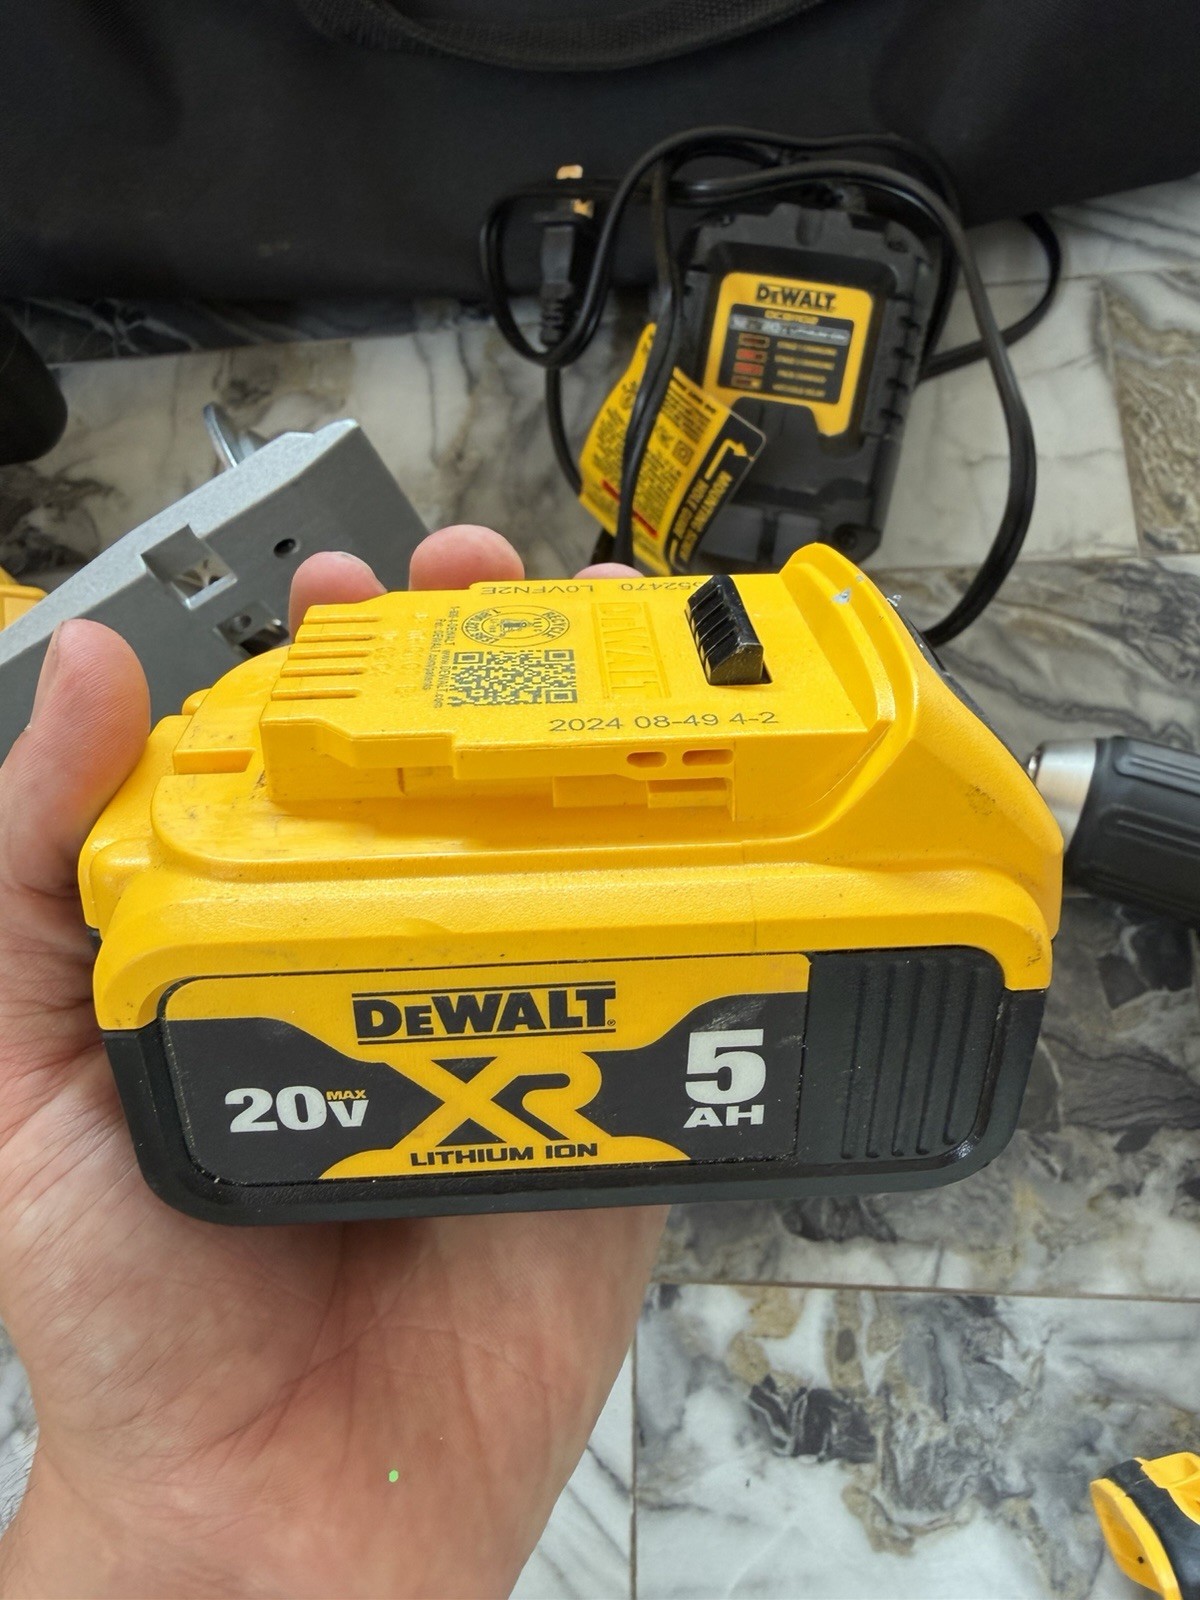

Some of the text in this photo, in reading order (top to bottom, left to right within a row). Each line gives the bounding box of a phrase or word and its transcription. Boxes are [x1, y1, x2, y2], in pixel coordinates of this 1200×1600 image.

[541, 611, 567, 639] RECYCLE
[549, 711, 779, 732] 2024 08-49 4-2
[353, 987, 616, 1040] DEWALT
[685, 1028, 767, 1105] 5
[326, 1089, 367, 1101] MAX
[390, 1050, 612, 1142] XR
[683, 1104, 765, 1129] AH
[410, 1143, 598, 1167] LITHIUM ION
